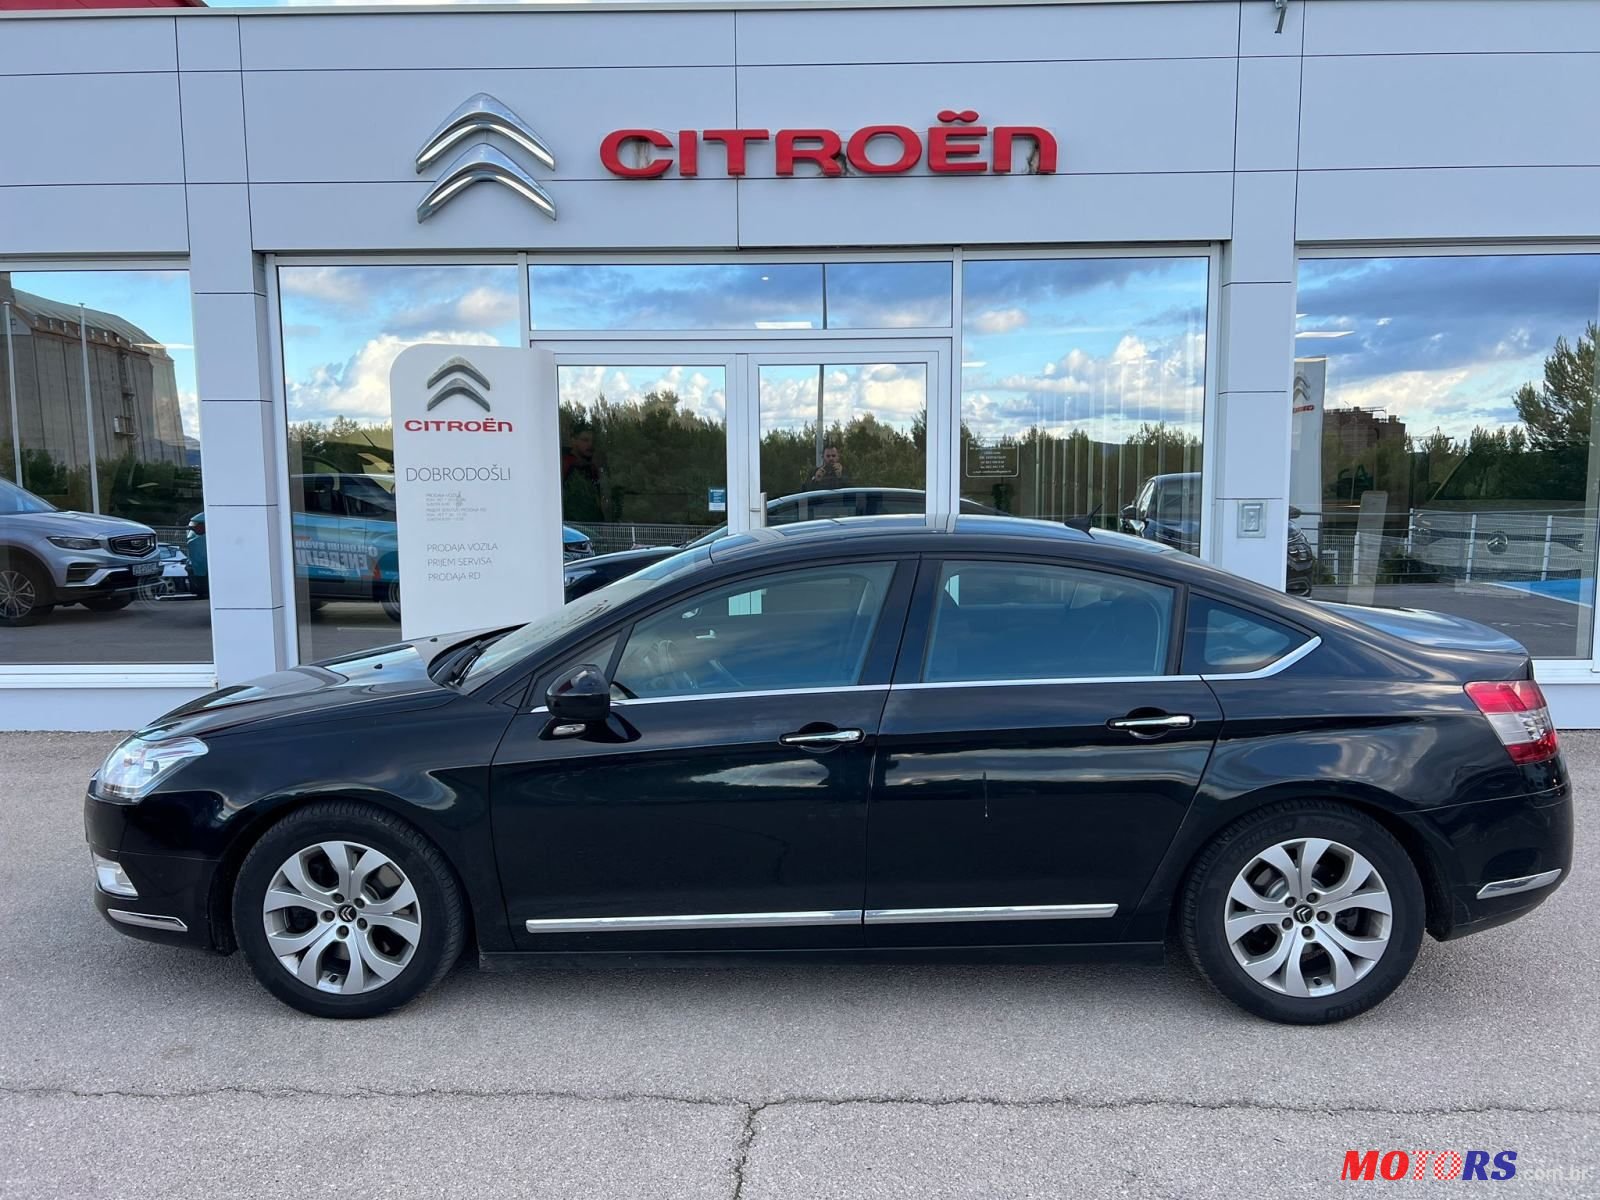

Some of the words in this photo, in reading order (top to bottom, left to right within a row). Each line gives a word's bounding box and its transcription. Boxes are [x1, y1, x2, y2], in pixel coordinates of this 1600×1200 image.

[405, 464, 511, 482] DOBRODOŠLI
[426, 543, 466, 553] PRODAJA
[467, 542, 498, 552] VOZILA
[427, 557, 456, 567] PRIJEM
[457, 556, 492, 566] SERVISA
[428, 572, 466, 582] PRODAJA
[468, 571, 481, 580] RD
